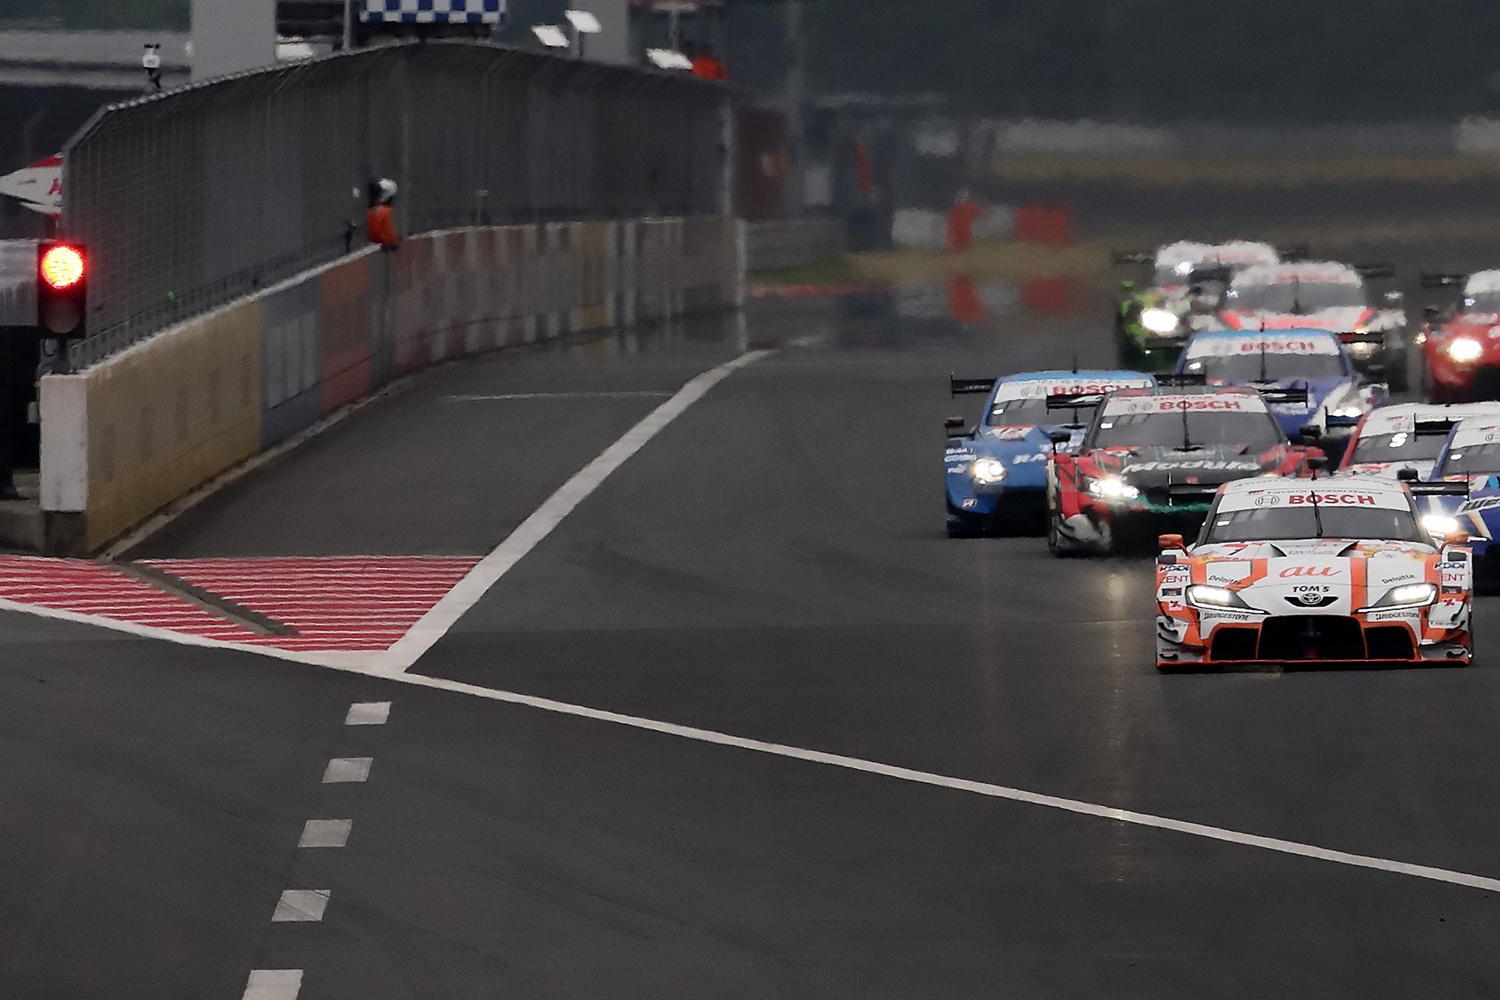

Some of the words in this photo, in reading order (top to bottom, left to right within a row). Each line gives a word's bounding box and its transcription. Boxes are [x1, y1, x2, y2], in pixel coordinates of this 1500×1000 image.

[1159, 400, 1241, 410] BOSCH
[1288, 494, 1376, 505] BOSCH
[1279, 565, 1342, 578] au
